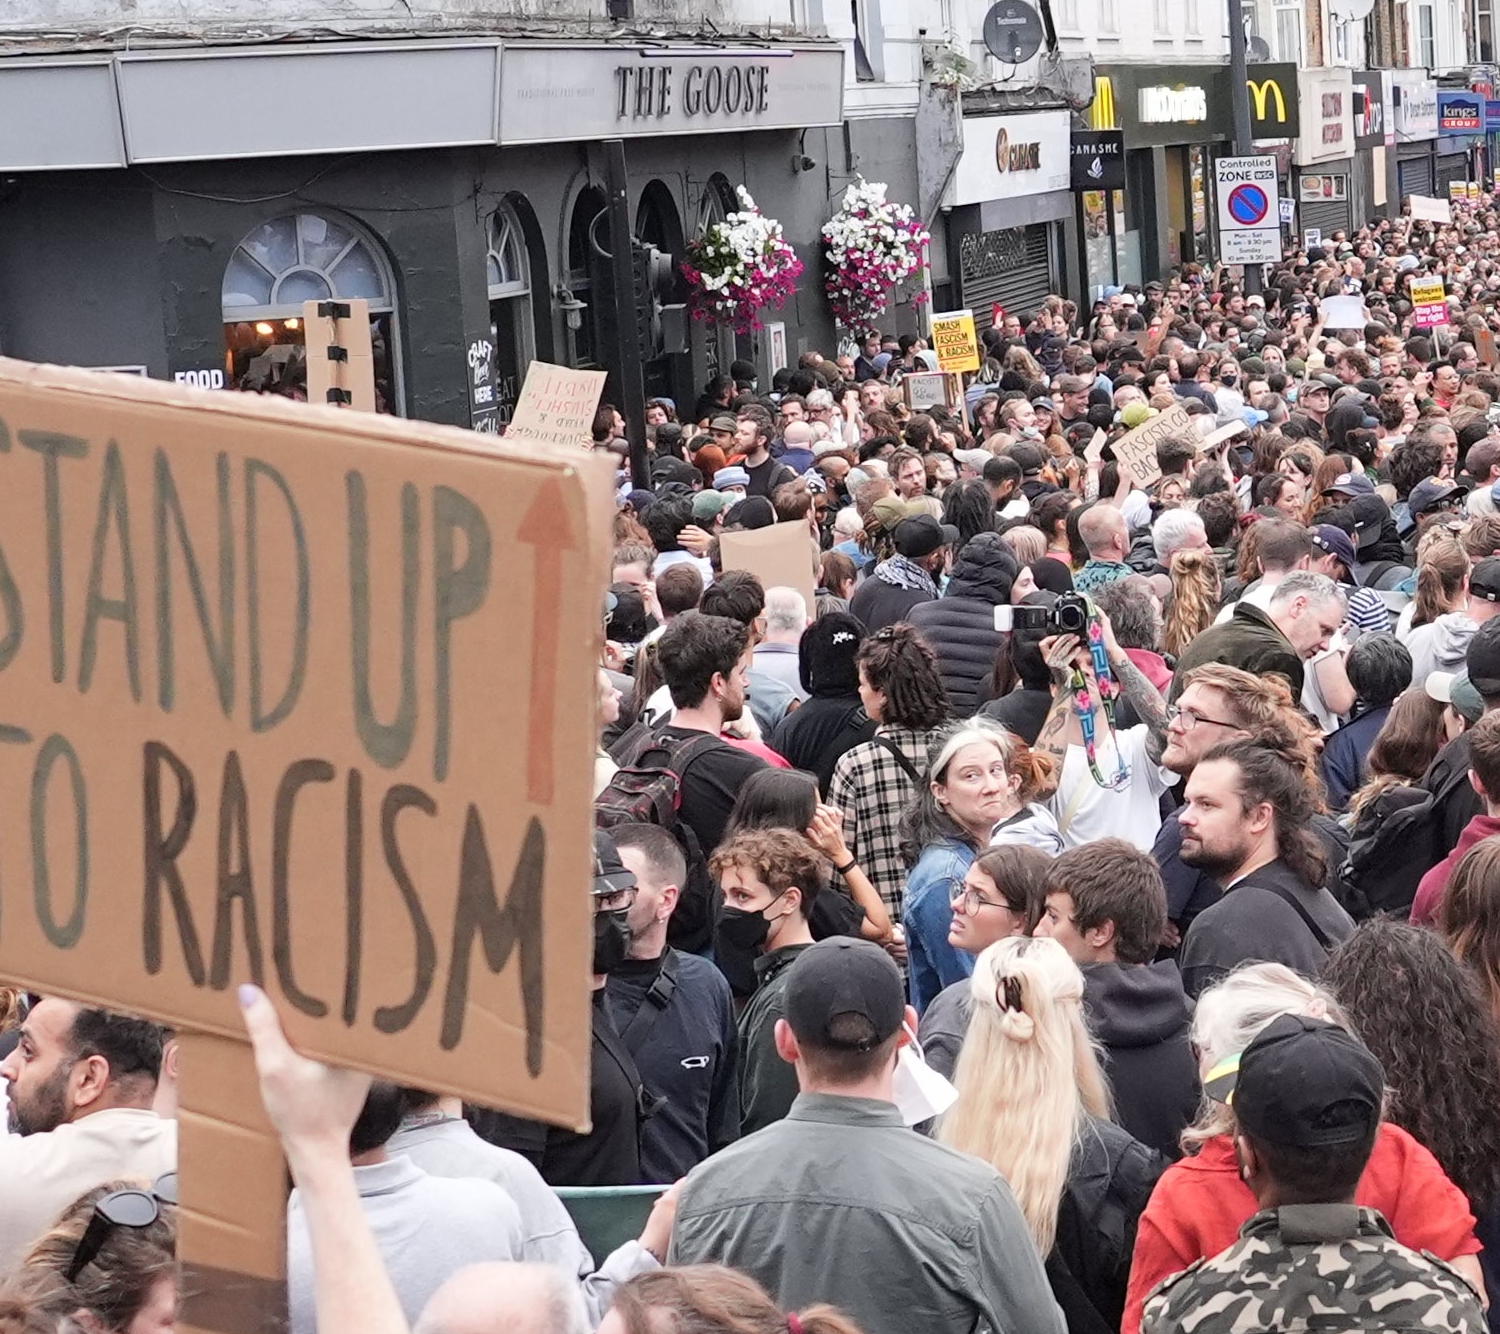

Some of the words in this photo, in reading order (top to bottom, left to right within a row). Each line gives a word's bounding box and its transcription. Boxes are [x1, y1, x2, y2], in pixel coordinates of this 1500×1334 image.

[613, 65, 673, 119] THE
[682, 65, 770, 117] GOOSE
[1443, 105, 1477, 118] kings
[1443, 119, 1477, 127] GROUP
[1219, 159, 1271, 169] Controlled
[1219, 171, 1252, 182] ZONE
[933, 320, 960, 333] SMASH
[935, 332, 968, 345] FASCISM
[467, 339, 493, 367] CRAFT
[946, 344, 975, 357] RACISM
[175, 369, 224, 389] FOOD
[474, 385, 494, 404] HERE
[1119, 416, 1174, 460] FASCISTS
[1132, 448, 1159, 481] BAC
[345, 469, 492, 783] UP
[142, 739, 547, 1079] RACISM
